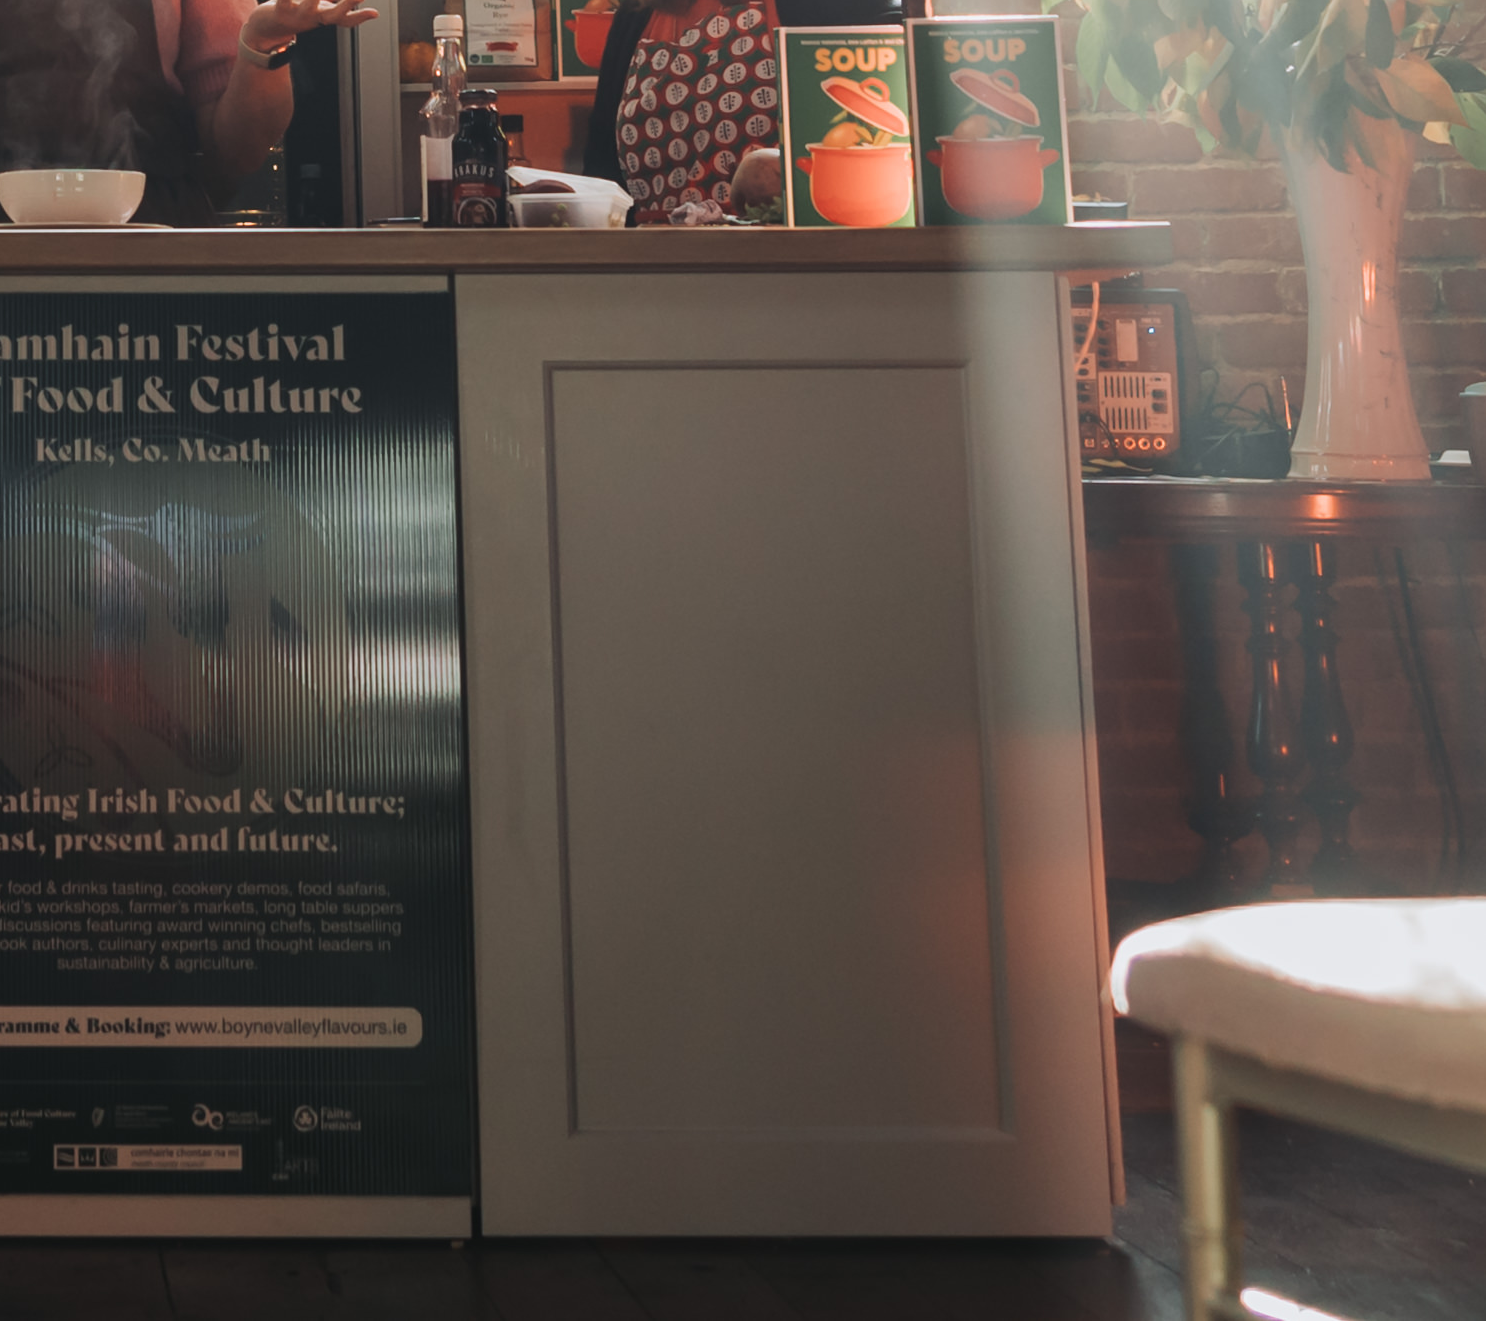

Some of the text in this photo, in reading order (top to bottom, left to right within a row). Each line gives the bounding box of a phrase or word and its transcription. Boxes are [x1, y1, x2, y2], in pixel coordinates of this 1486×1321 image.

[814, 47, 897, 72] SOUP
[943, 38, 1026, 63] SOUP
[174, 323, 346, 361] Festival
[11, 376, 124, 414] Food
[137, 376, 176, 414] &
[190, 376, 364, 414] Culture
[36, 437, 272, 466] Kells, Co. Meath
[88, 788, 157, 814] Irish
[166, 788, 241, 814] Food
[250, 788, 275, 814] &
[283, 788, 406, 818] Culture;
[54, 830, 164, 860] present
[173, 826, 228, 852] and
[236, 826, 338, 853] future.
[7, 880, 42, 896] food
[46, 880, 57, 896] &
[61, 880, 108, 896] drinks
[112, 881, 167, 899] tasting,
[171, 882, 233, 899] cookery
[237, 882, 293, 897] demos,
[298, 882, 332, 896] food
[337, 882, 390, 898] safaris,
[36, 899, 124, 917] workshops,
[194, 900, 259, 916] markets,
[264, 900, 296, 918] long
[301, 900, 337, 915] table
[342, 903, 404, 918] suppers
[86, 918, 152, 936] featuring
[156, 918, 203, 933] award
[208, 919, 266, 936] winning
[270, 919, 315, 934] chefs,
[321, 919, 402, 936] bestselling
[98, 938, 157, 954] culinary
[161, 938, 218, 954] experts
[222, 937, 251, 951] and
[255, 937, 313, 954] thought
[318, 937, 374, 951] leaders
[378, 937, 391, 951] in
[56, 956, 258, 973] sustainability & agriculture.
[65, 1017, 81, 1034] &
[86, 1017, 170, 1038] Booking:
[175, 1018, 407, 1039] www.boynevalleyflavours.ie
